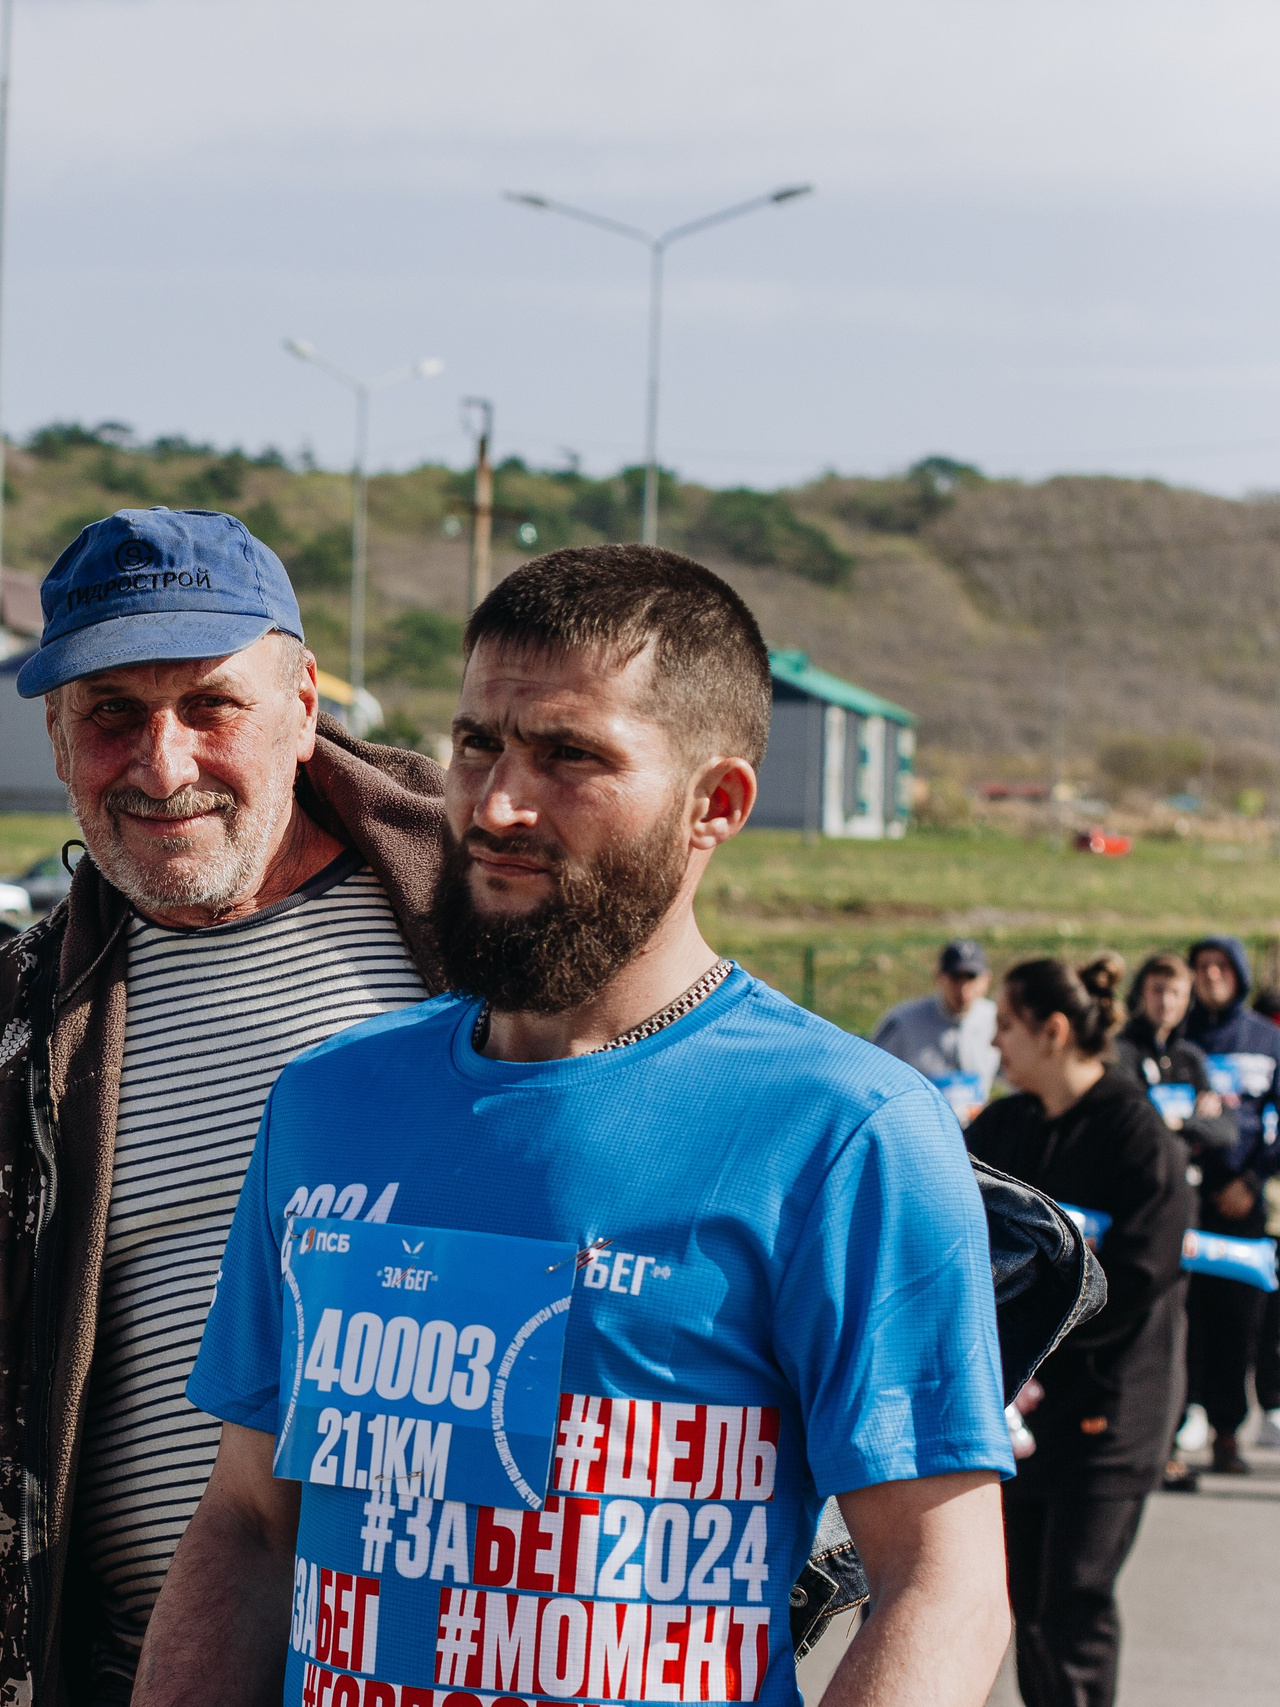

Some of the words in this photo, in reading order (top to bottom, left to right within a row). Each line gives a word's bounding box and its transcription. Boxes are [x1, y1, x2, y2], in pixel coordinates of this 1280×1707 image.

[67, 568, 211, 613] ГИДРОСТРОЙ
[315, 1231, 350, 1253] ПСБ
[304, 1308, 497, 1411] 40003
[496, 1306, 552, 1380] #САМОВЫРАЖЕНИЕ
[491, 1378, 508, 1430] #ГОРДОСТЬ
[554, 1393, 778, 1502] #ЦЕЛЬ
[493, 1430, 522, 1483] #ЕДИНСТВО
[360, 1489, 769, 1602] #ЗАБЕГ2024
[290, 1553, 380, 1675] ЗАБЕГ
[435, 1587, 771, 1702] #МОМЕНТ
